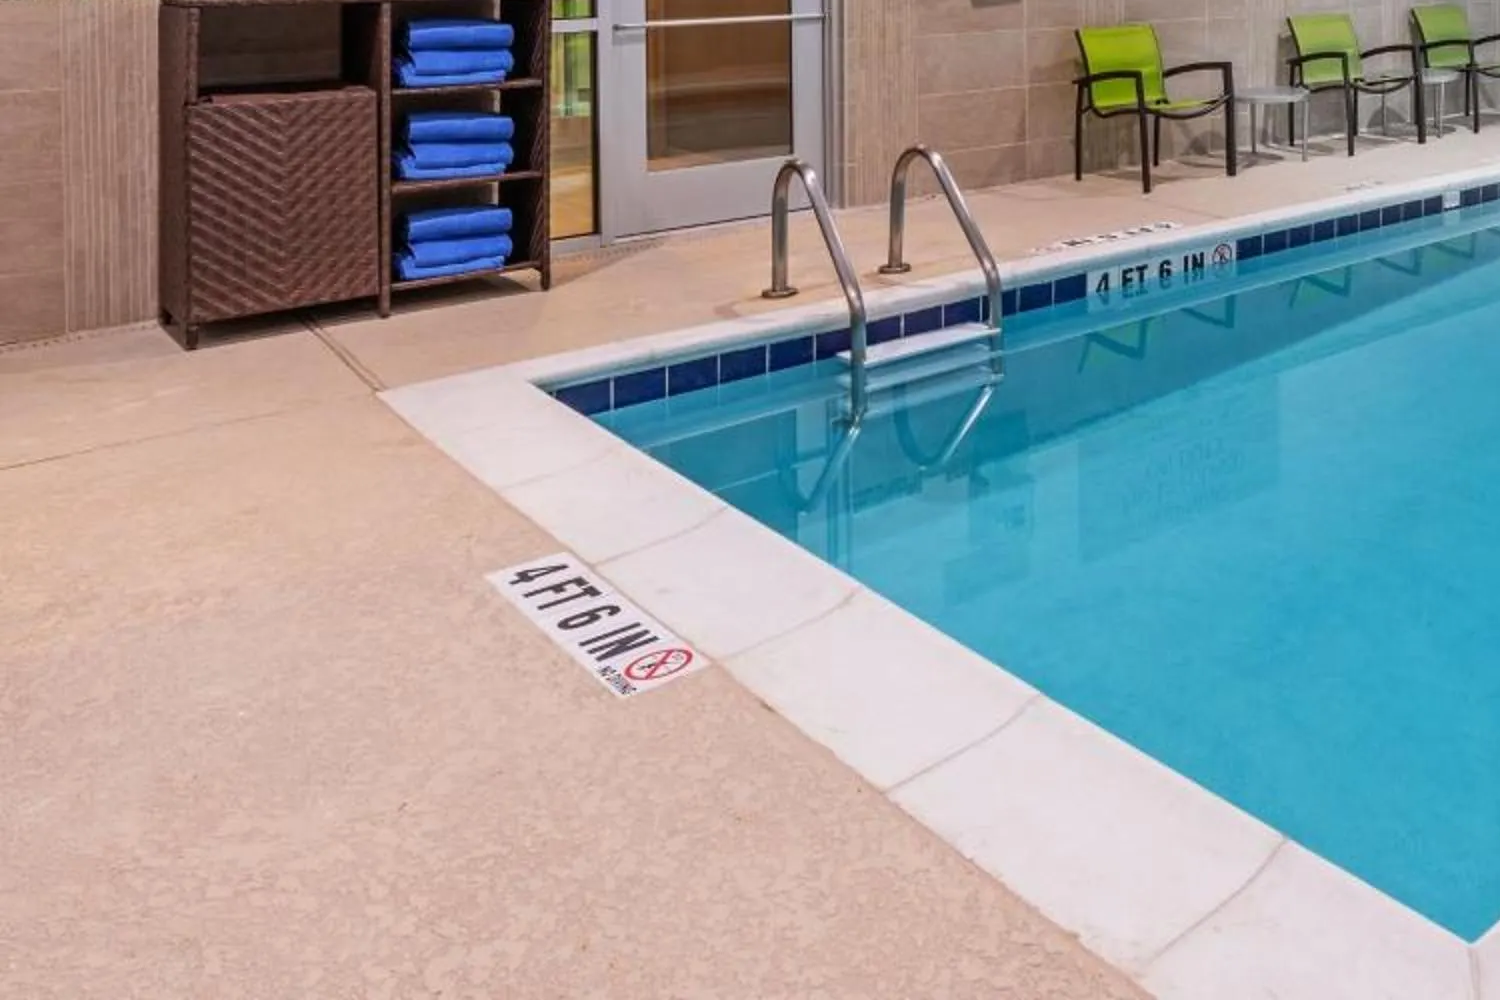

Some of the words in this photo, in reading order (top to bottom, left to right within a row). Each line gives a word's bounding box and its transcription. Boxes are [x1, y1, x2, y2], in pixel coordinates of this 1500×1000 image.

[1096, 272, 1110, 292] 4
[1121, 264, 1149, 287] FT
[1159, 259, 1172, 280] 6
[1183, 252, 1205, 273] IN
[508, 563, 569, 585] 4
[522, 576, 603, 611] FT
[556, 604, 621, 631] 6
[578, 621, 660, 663] IN
